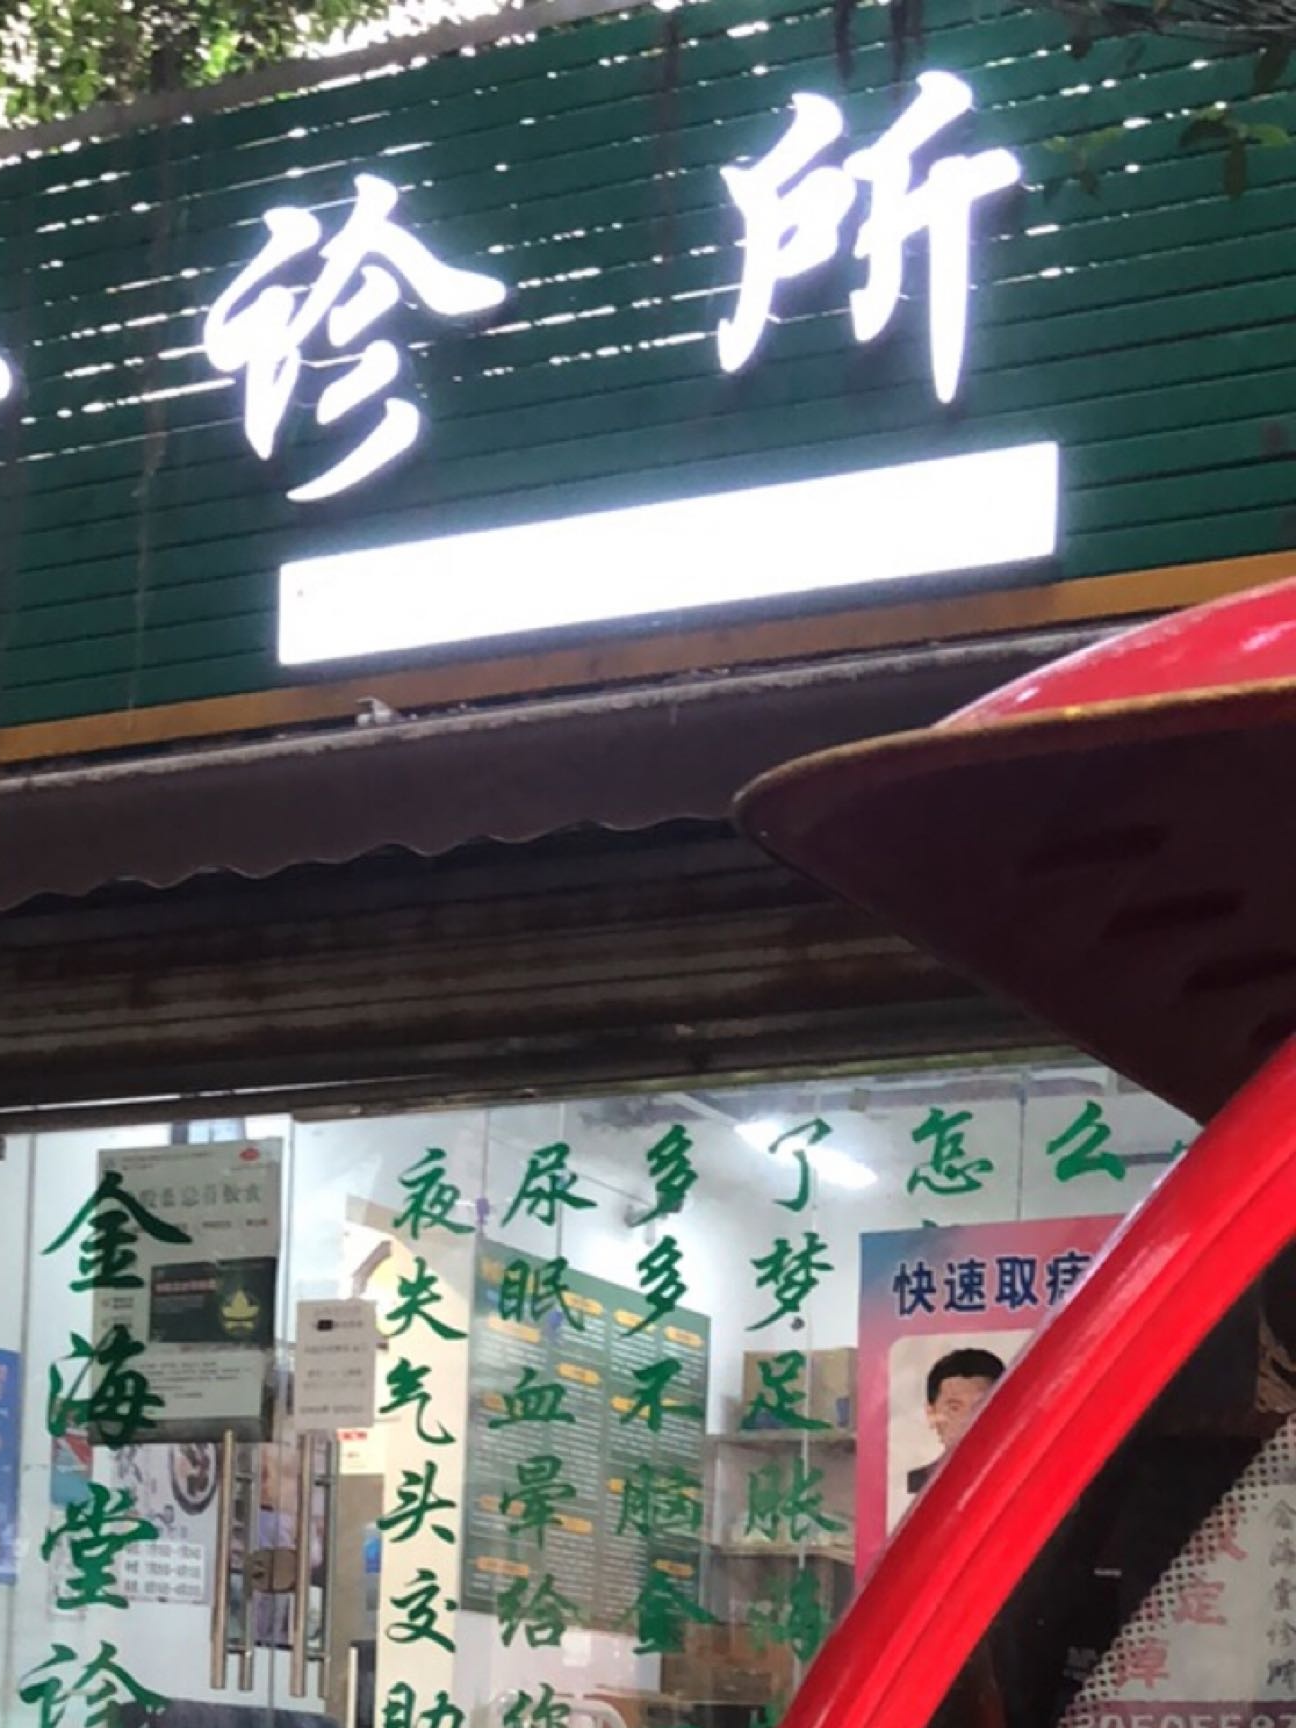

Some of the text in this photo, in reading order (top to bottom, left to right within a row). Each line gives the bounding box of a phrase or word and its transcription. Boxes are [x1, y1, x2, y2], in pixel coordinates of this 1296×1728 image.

[390, 1100, 1187, 1239] 夜尿多了怎么
